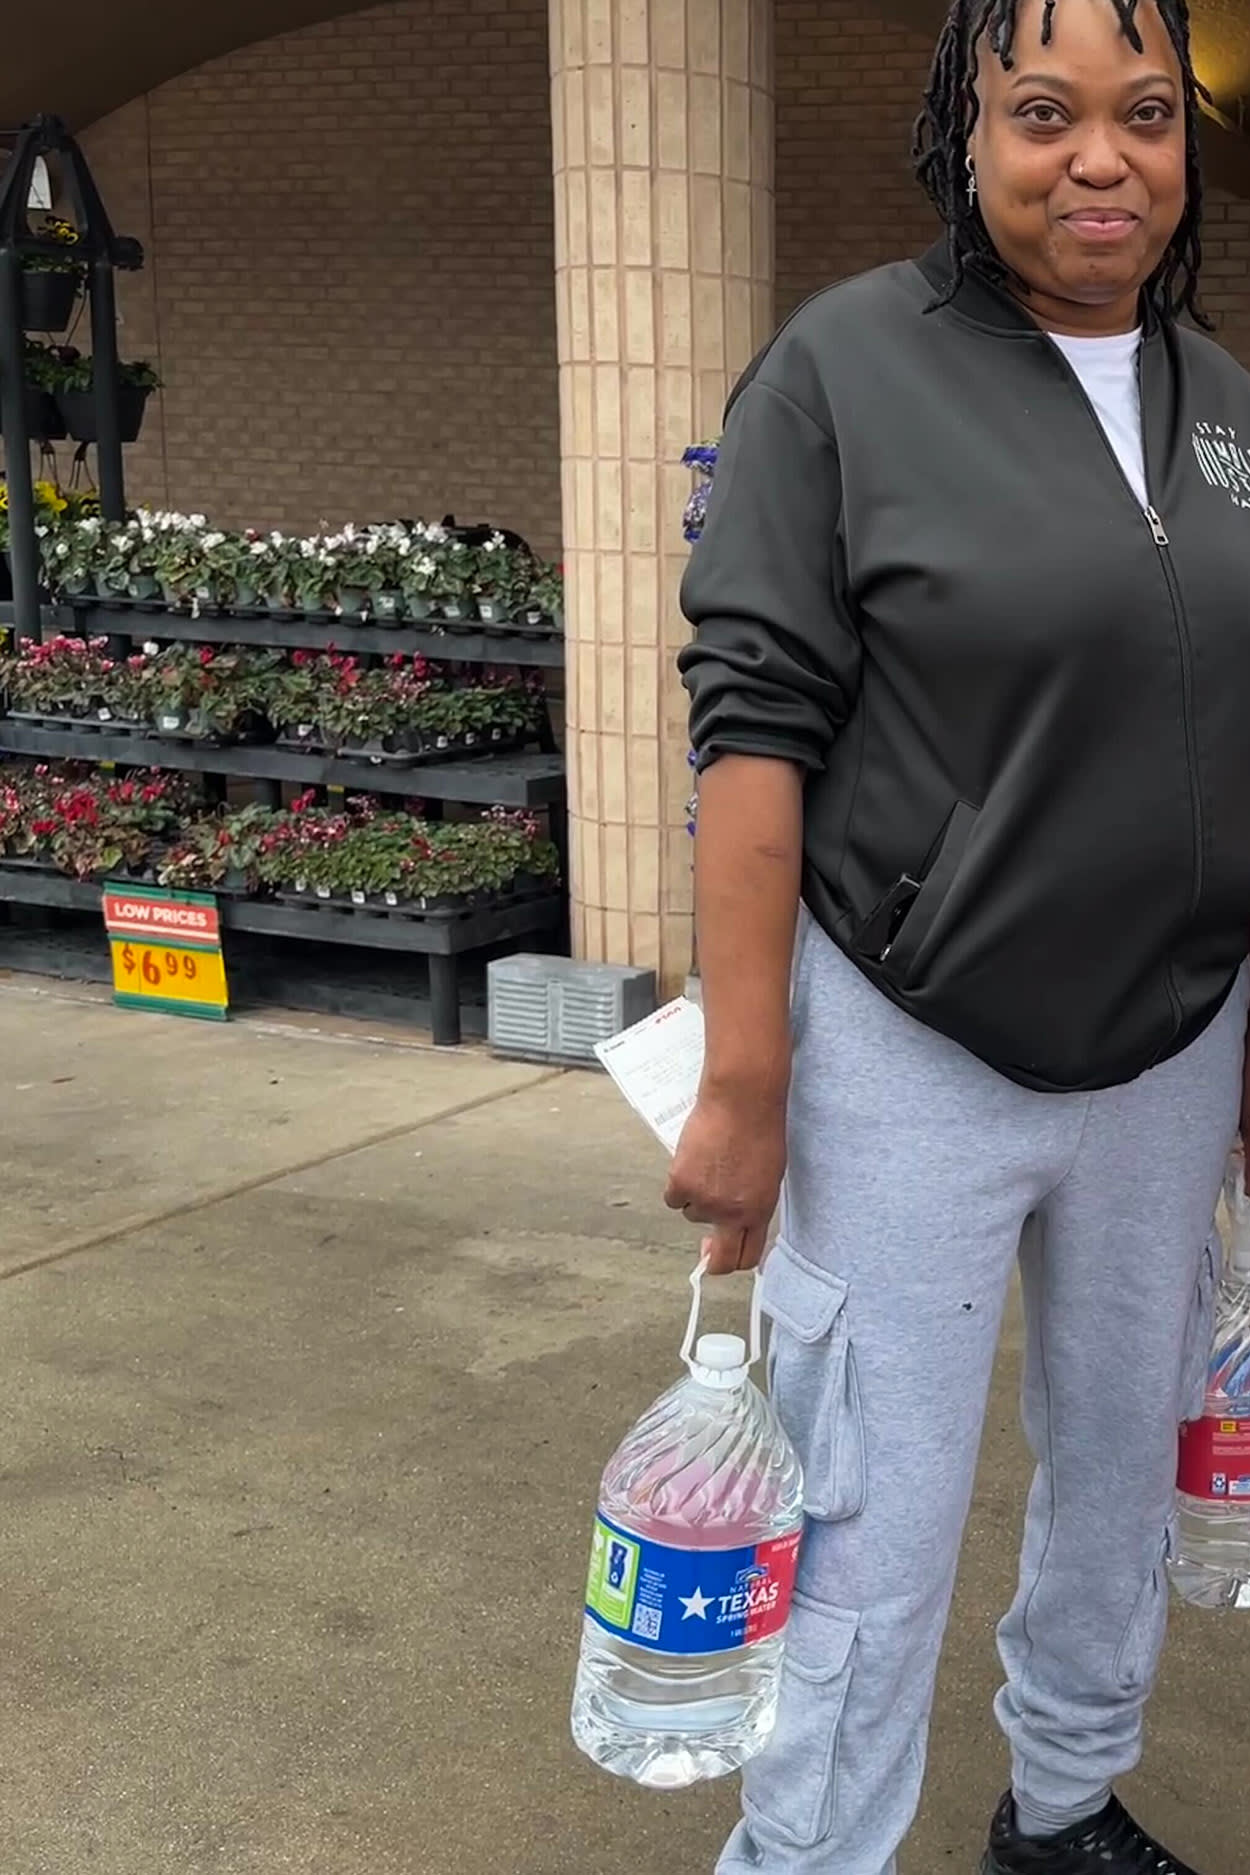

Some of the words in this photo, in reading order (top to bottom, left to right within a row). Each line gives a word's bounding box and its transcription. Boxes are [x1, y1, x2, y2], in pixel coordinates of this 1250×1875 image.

[1196, 422, 1235, 439] STAY
[114, 902, 150, 920] LOW
[152, 907, 207, 927] PRICES
[718, 1582, 779, 1614] TEXAS
